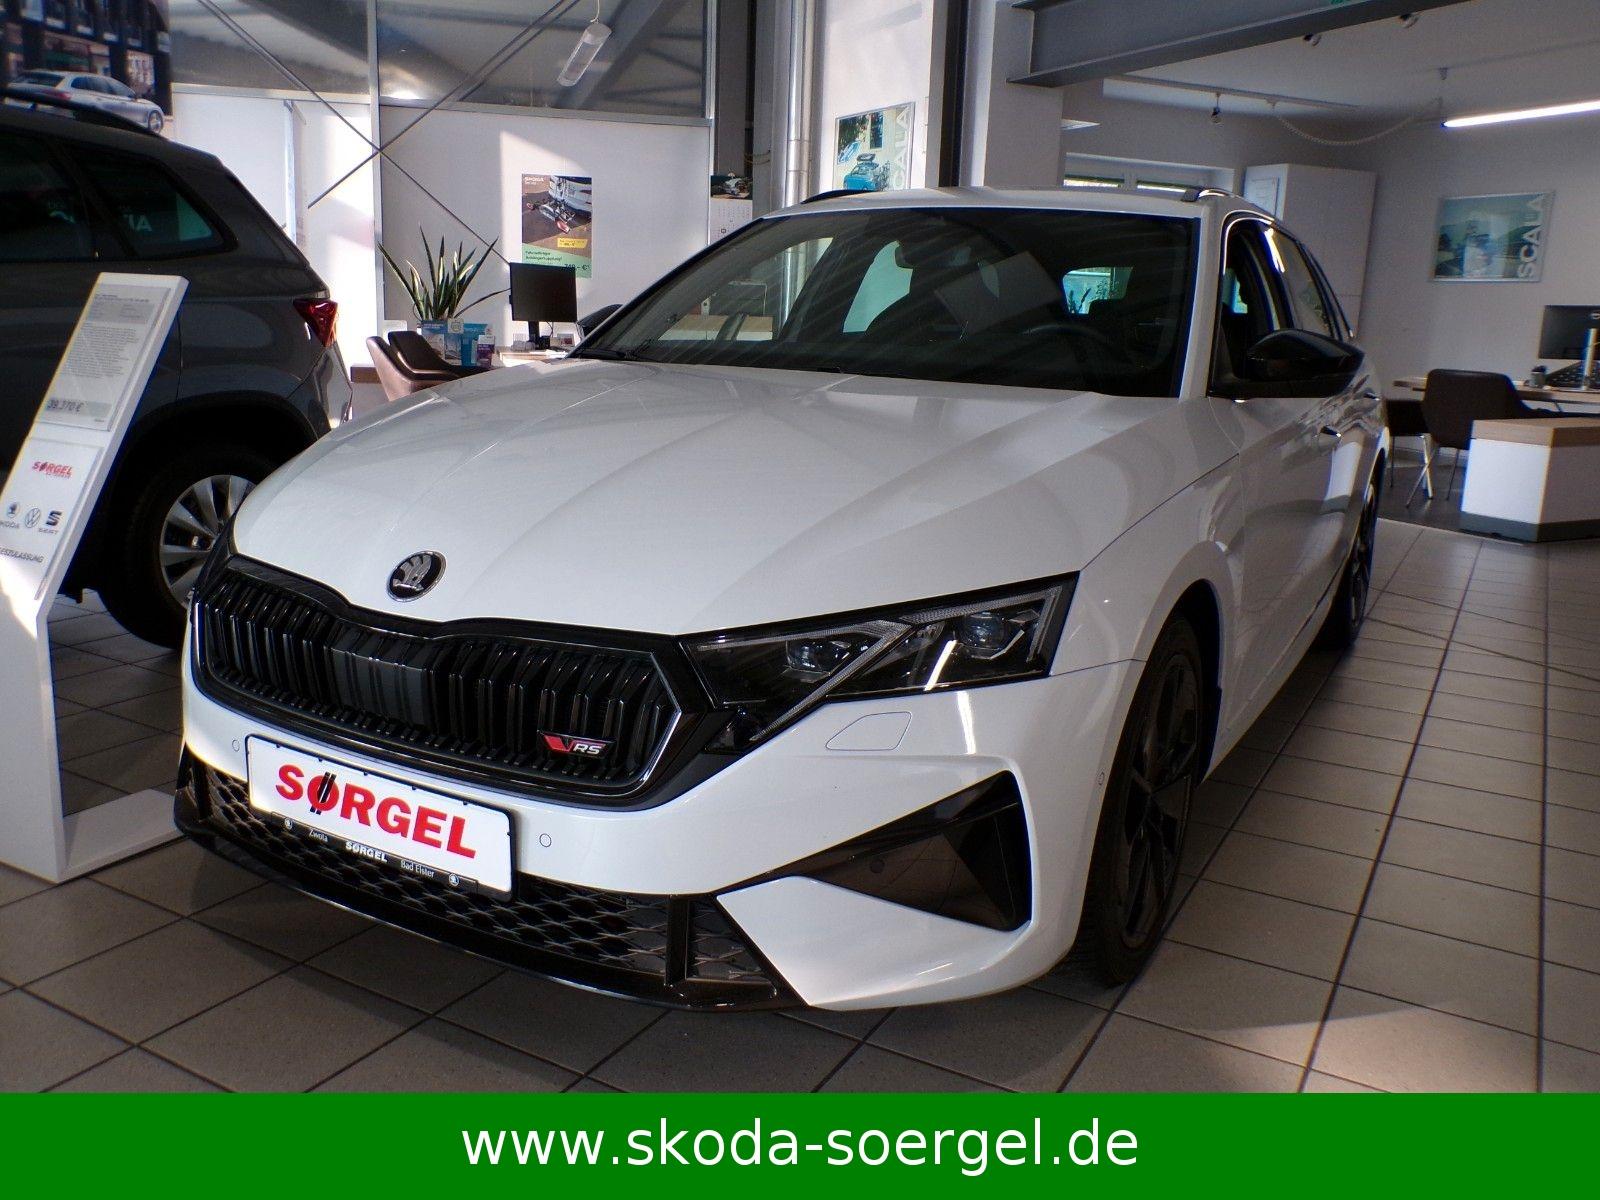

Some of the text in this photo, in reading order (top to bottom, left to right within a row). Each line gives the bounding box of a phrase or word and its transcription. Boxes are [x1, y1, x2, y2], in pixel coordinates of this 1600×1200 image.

[1517, 194, 1544, 278] SCALA
[400, 859, 414, 871] Bad
[415, 863, 435, 878] Elster
